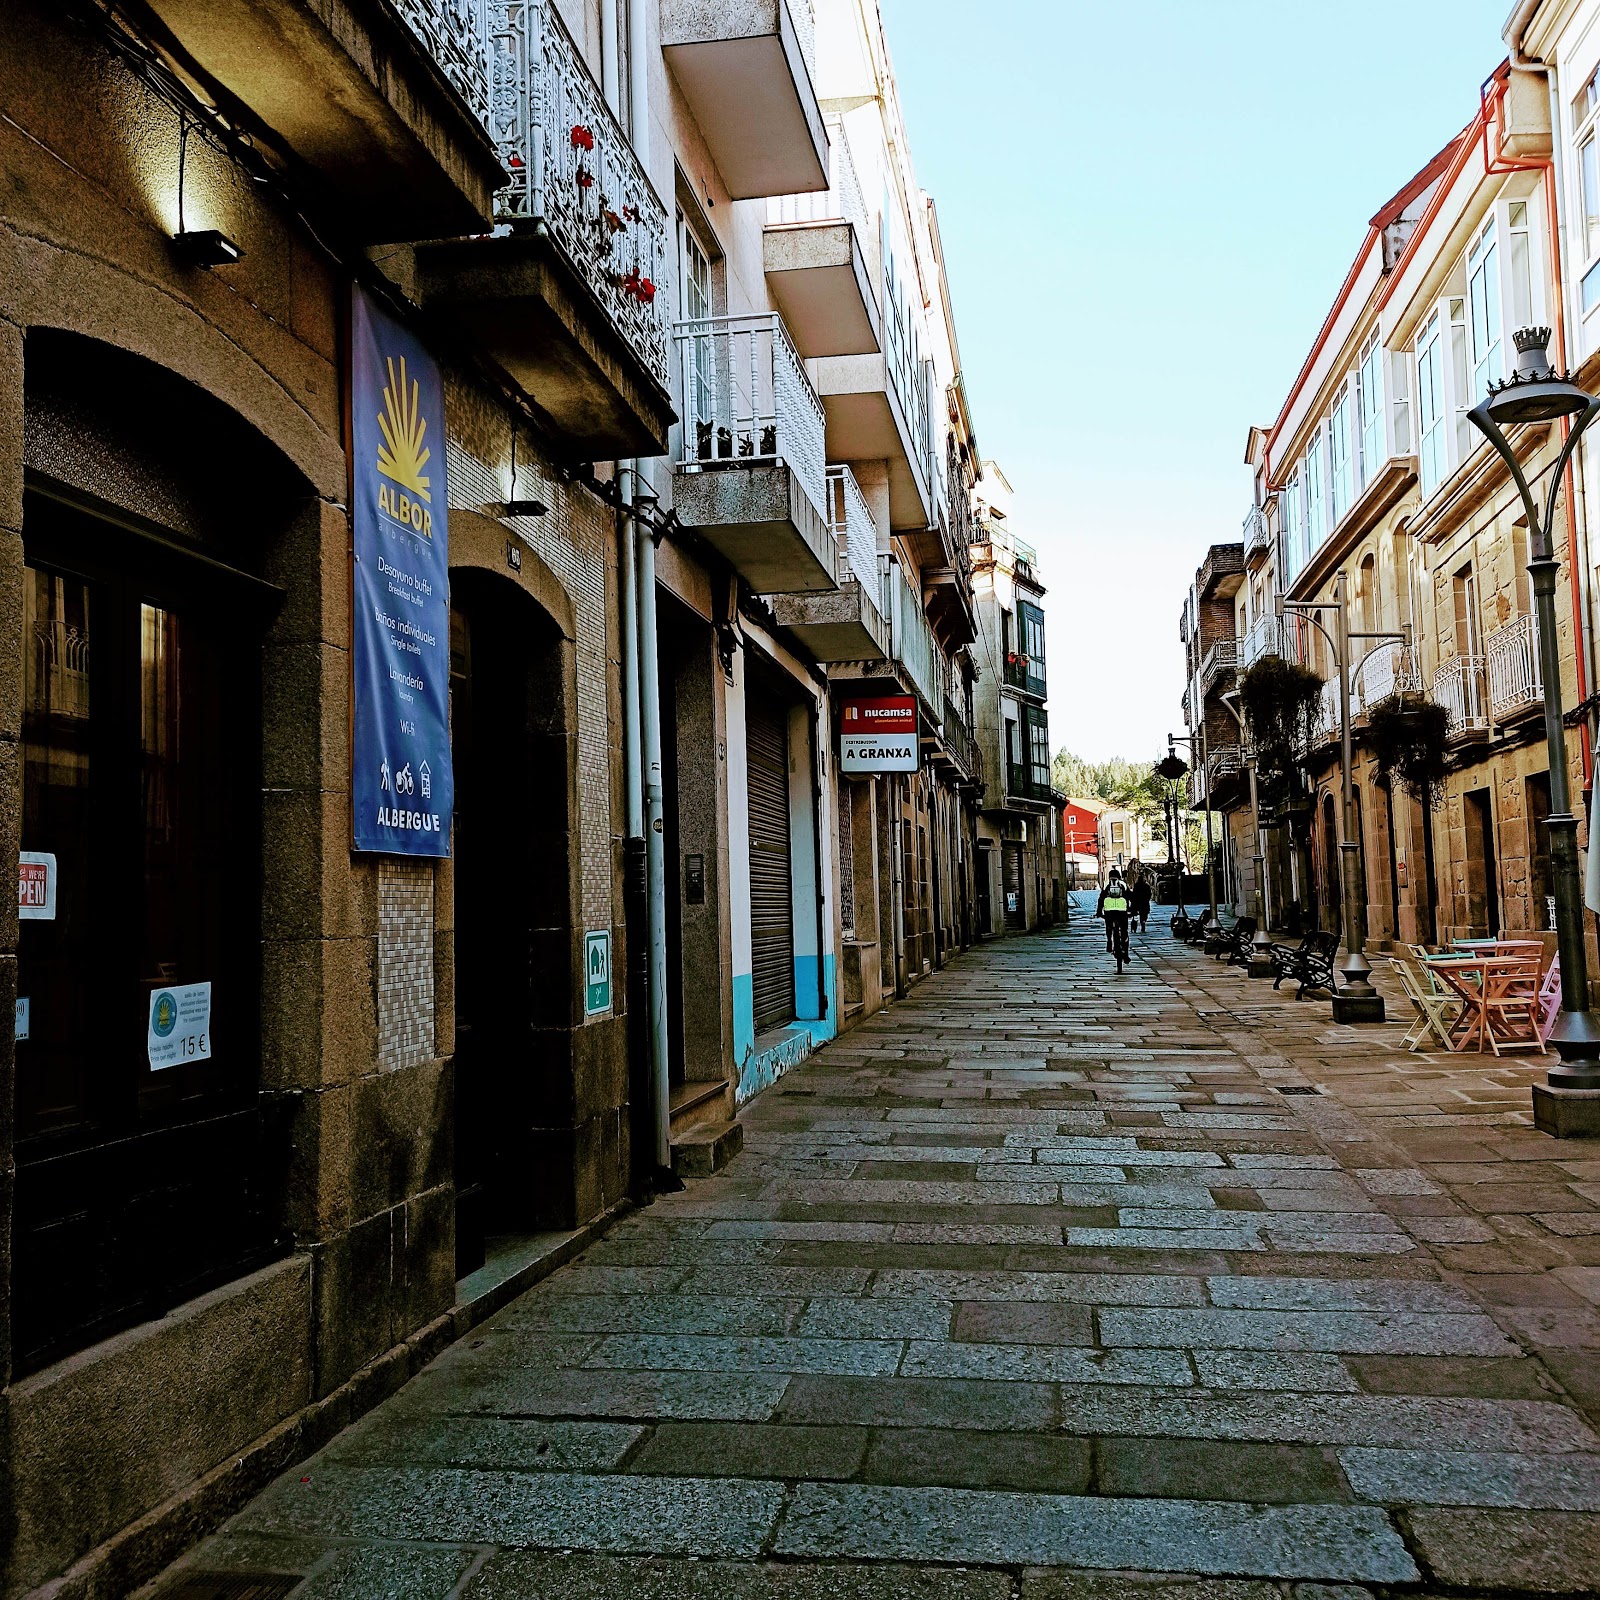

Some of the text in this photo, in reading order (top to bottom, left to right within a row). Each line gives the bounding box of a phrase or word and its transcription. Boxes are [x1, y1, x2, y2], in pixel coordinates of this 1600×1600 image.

[378, 482, 432, 539] ALBOR
[378, 523, 432, 559] albergue
[378, 556, 432, 596] Desayuno buffet
[388, 582, 424, 607] Breakfast buffet
[375, 606, 436, 646] Baños individuales
[390, 635, 421, 655] Single toilets
[389, 664, 423, 690] Lavandería
[398, 688, 414, 705] laundry
[864, 709, 912, 717] nucamsa
[846, 748, 911, 758] A GRANXA
[377, 806, 440, 831] ALBERGUE
[28, 870, 45, 880] WE'RE
[18, 880, 44, 904] PEN
[181, 1034, 206, 1056] 15 €
